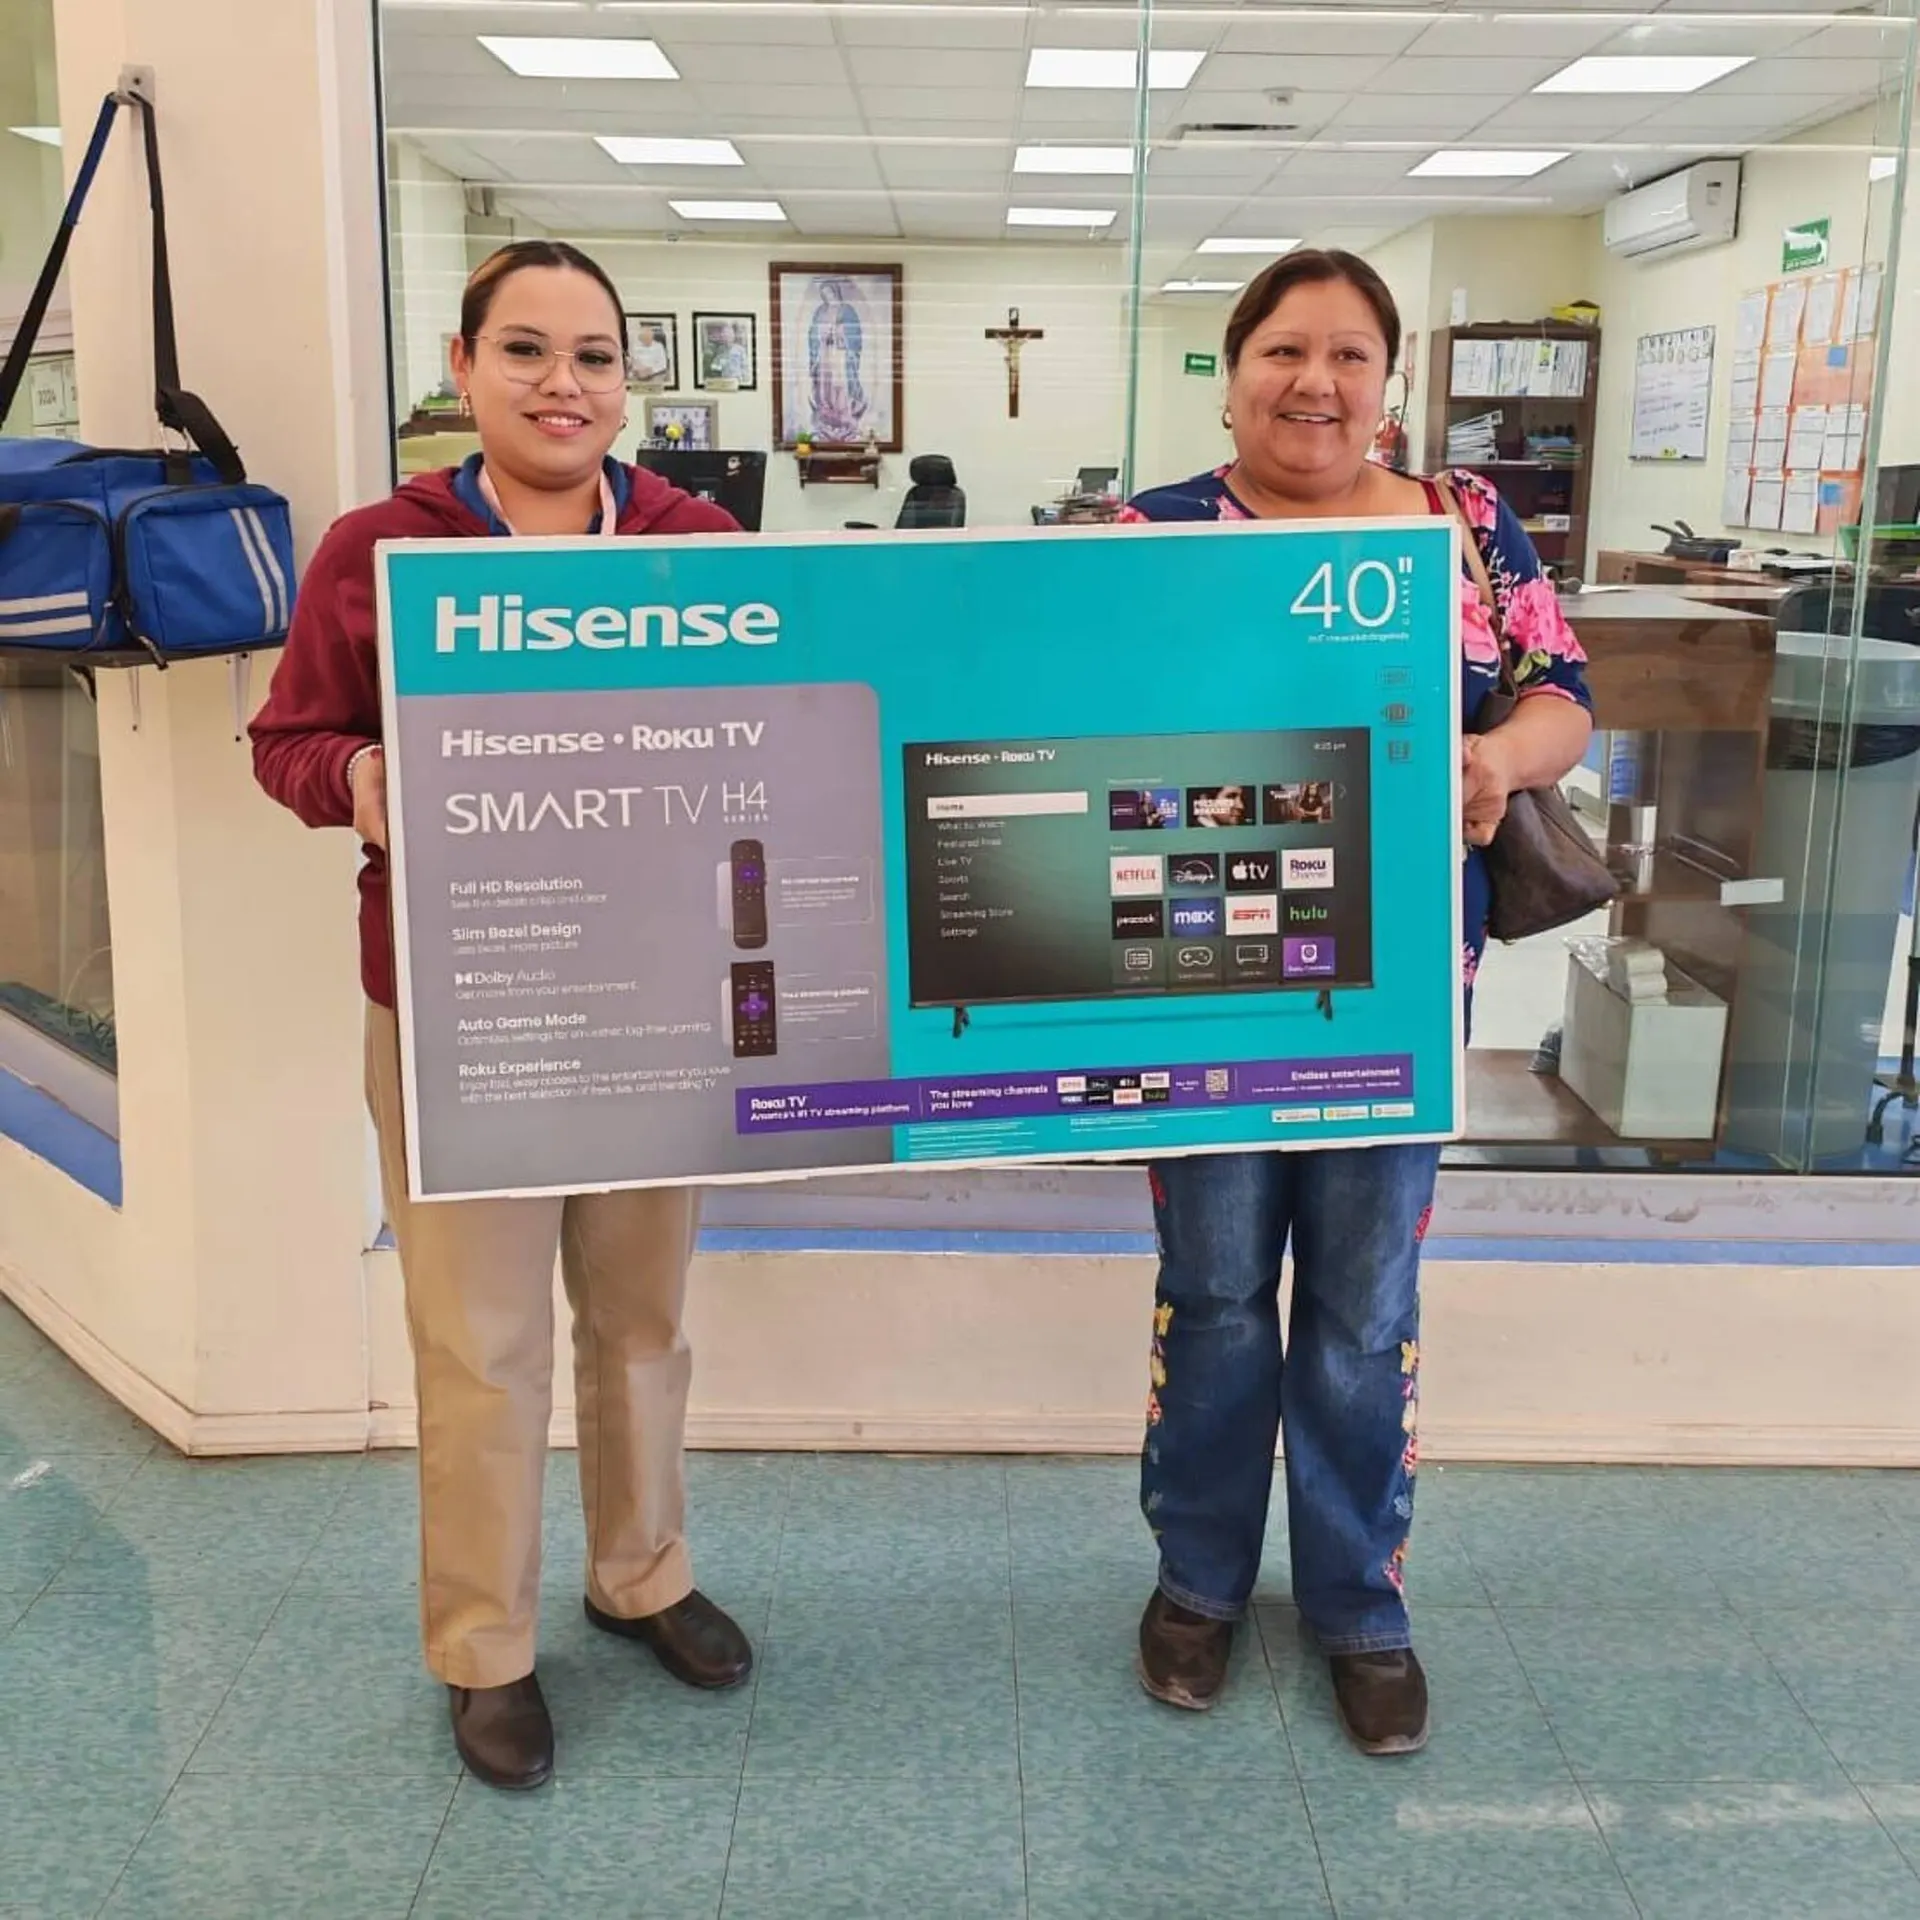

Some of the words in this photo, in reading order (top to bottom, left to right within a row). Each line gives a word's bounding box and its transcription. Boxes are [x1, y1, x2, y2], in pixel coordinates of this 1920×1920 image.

[436, 594, 780, 654] Hisense
[442, 729, 605, 757] Hisense
[632, 725, 714, 750] Roku
[720, 721, 765, 748] TV
[925, 752, 991, 767] Hisense
[1037, 749, 1056, 762] TV
[445, 787, 644, 835] SMART
[653, 785, 709, 825] TV
[722, 781, 768, 813] H4
[1250, 863, 1269, 880] tv
[1290, 859, 1327, 871] Roku
[1116, 869, 1156, 881] NETFLIX
[450, 880, 477, 895] Full
[479, 880, 501, 894] HD
[504, 876, 584, 893] Resolution
[1116, 913, 1155, 928] peacock
[1174, 910, 1216, 925] max
[1232, 908, 1271, 921] ESPN
[1290, 906, 1328, 920] hulu
[452, 926, 486, 941] Slim
[488, 923, 528, 940] Bezel
[530, 921, 582, 940] Design
[475, 971, 514, 987] Dolby
[517, 967, 557, 982] Audio
[457, 1018, 494, 1033] Auto
[496, 1015, 542, 1030] Game
[545, 1011, 587, 1027] Mode
[458, 1062, 497, 1077] Roku
[499, 1057, 582, 1077] Experience
[929, 1090, 950, 1100] The
[951, 1087, 1002, 1098] streaming
[750, 1098, 786, 1111] Roku
[787, 1096, 807, 1108] TV
[809, 1108, 822, 1117] TV
